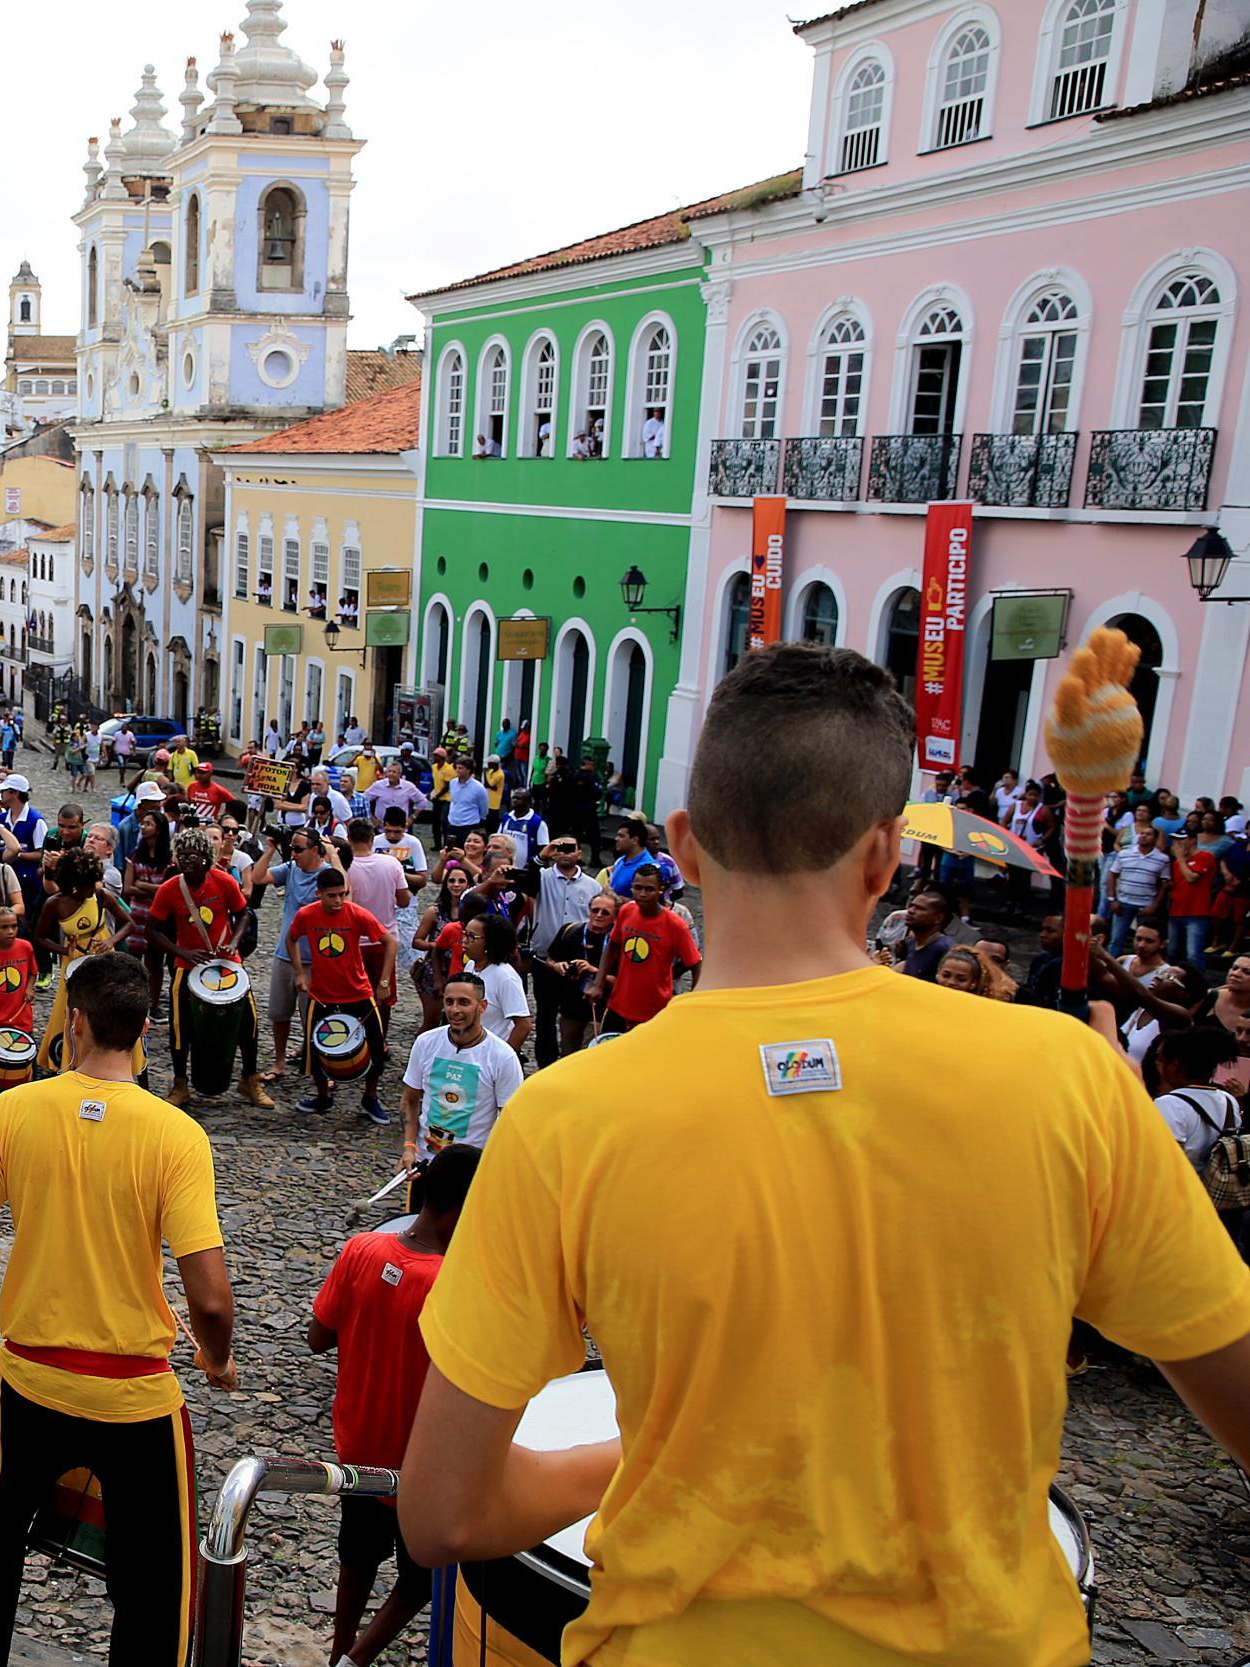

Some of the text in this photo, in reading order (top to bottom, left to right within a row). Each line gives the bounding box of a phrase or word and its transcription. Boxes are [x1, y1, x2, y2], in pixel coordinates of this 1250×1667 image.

[766, 534, 783, 590] CUIDO
[947, 527, 968, 631] PARTICIPO
[751, 574, 766, 649] #MUSEU
[923, 616, 945, 695] #MUSEU
[446, 1071, 463, 1081] PAZ
[777, 1057, 824, 1071] OLODUM
